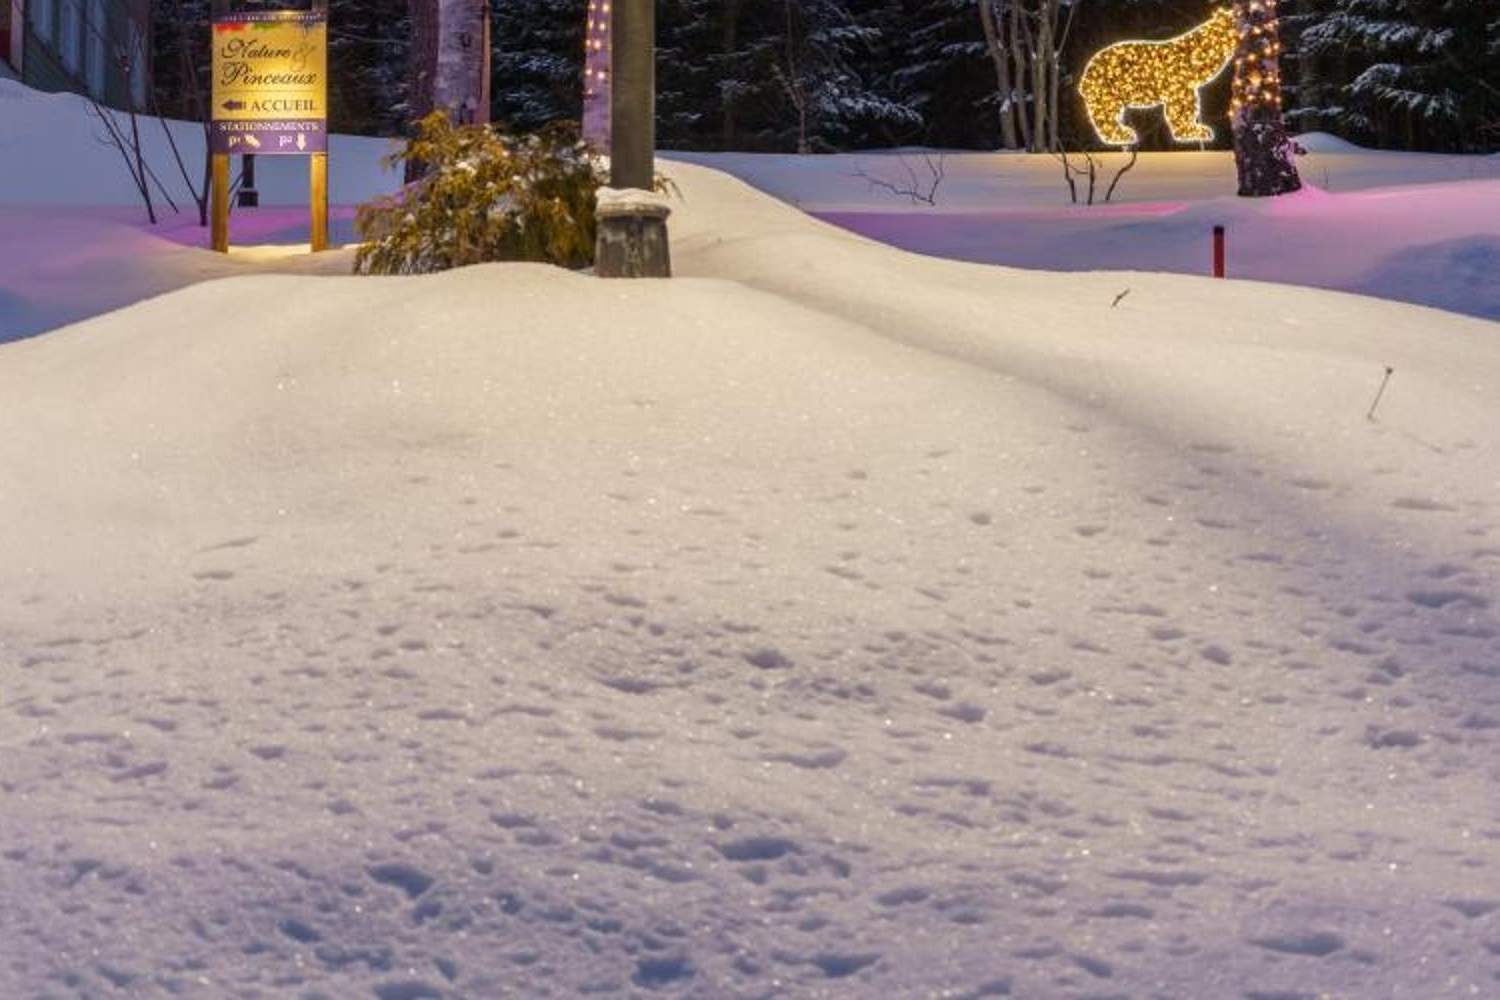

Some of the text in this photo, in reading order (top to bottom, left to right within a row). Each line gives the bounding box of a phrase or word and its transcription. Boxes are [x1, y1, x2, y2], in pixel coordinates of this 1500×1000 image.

[221, 38, 292, 59] Nature
[221, 61, 317, 86] Pinceaux
[251, 99, 316, 112] ACCUEIL
